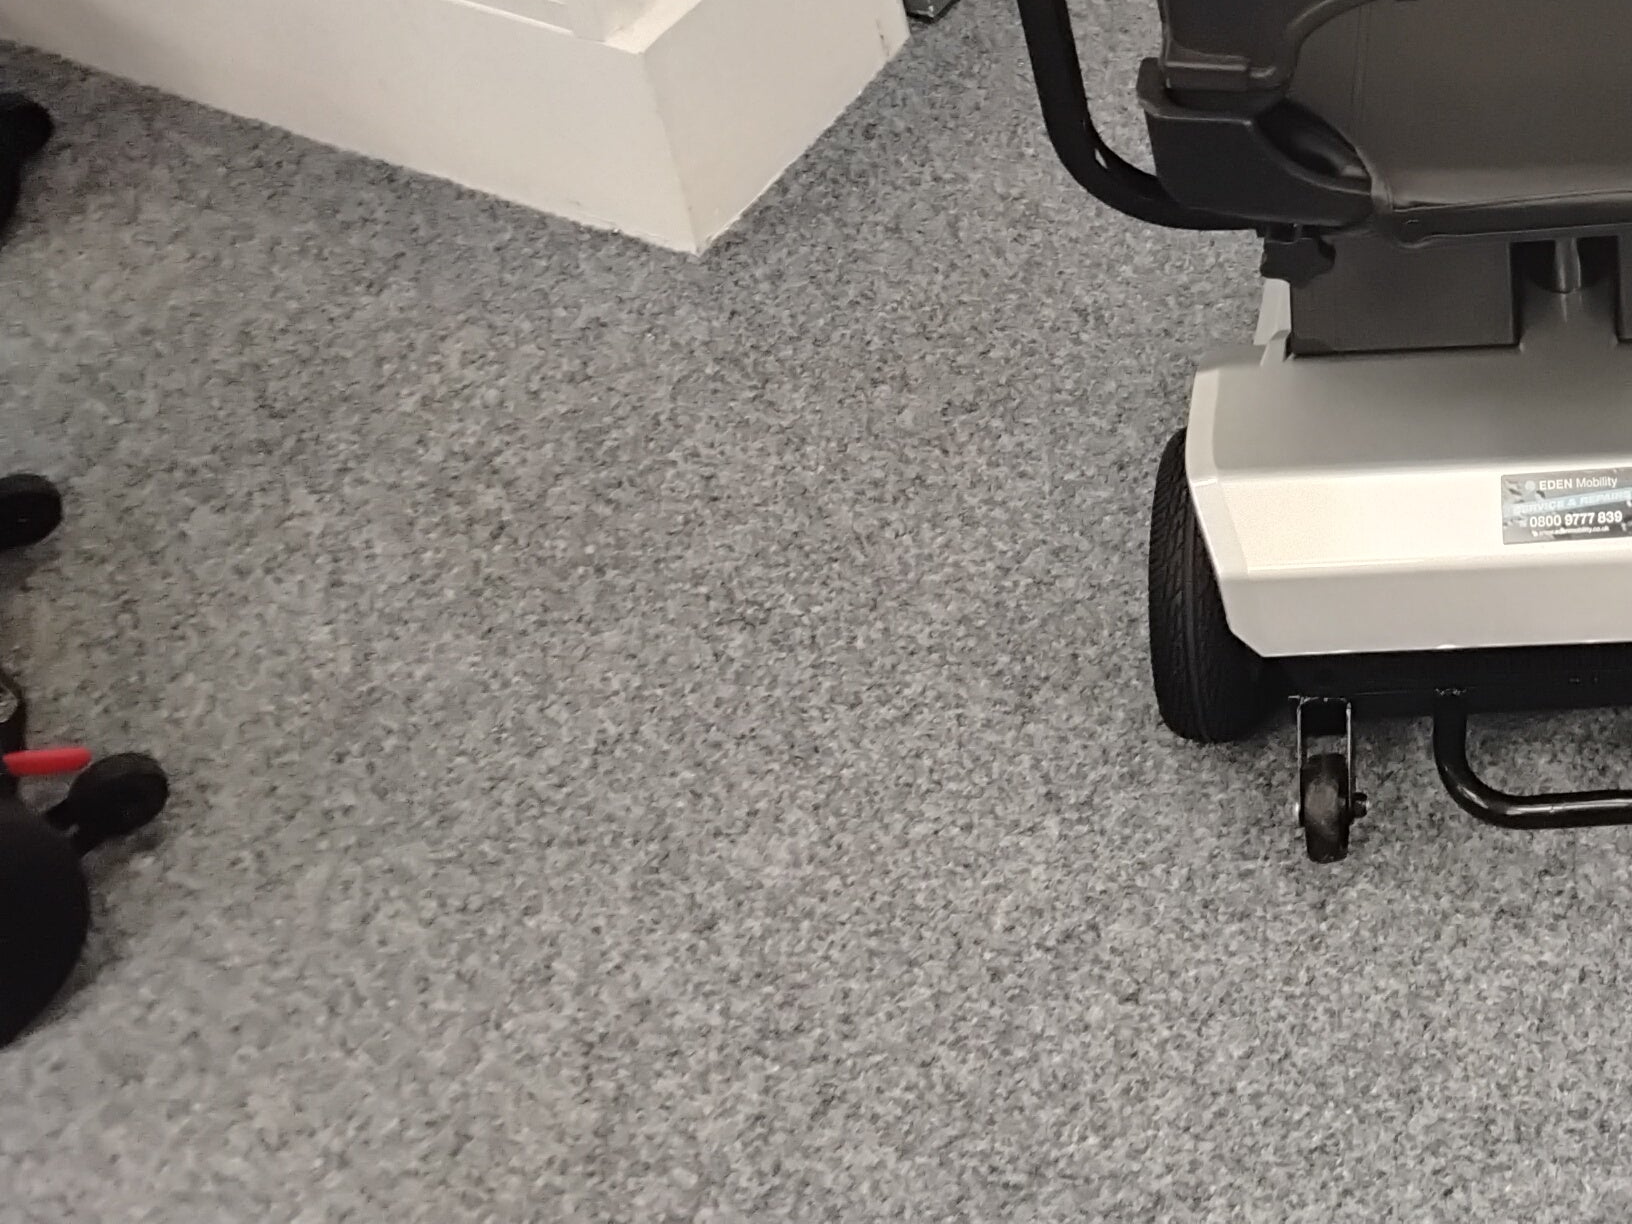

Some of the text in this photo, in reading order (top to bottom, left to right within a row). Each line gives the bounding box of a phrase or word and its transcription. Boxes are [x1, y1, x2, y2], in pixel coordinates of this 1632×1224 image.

[1538, 476, 1618, 491] EDEN Mobility
[1529, 510, 1623, 528] 0800 9777 839
